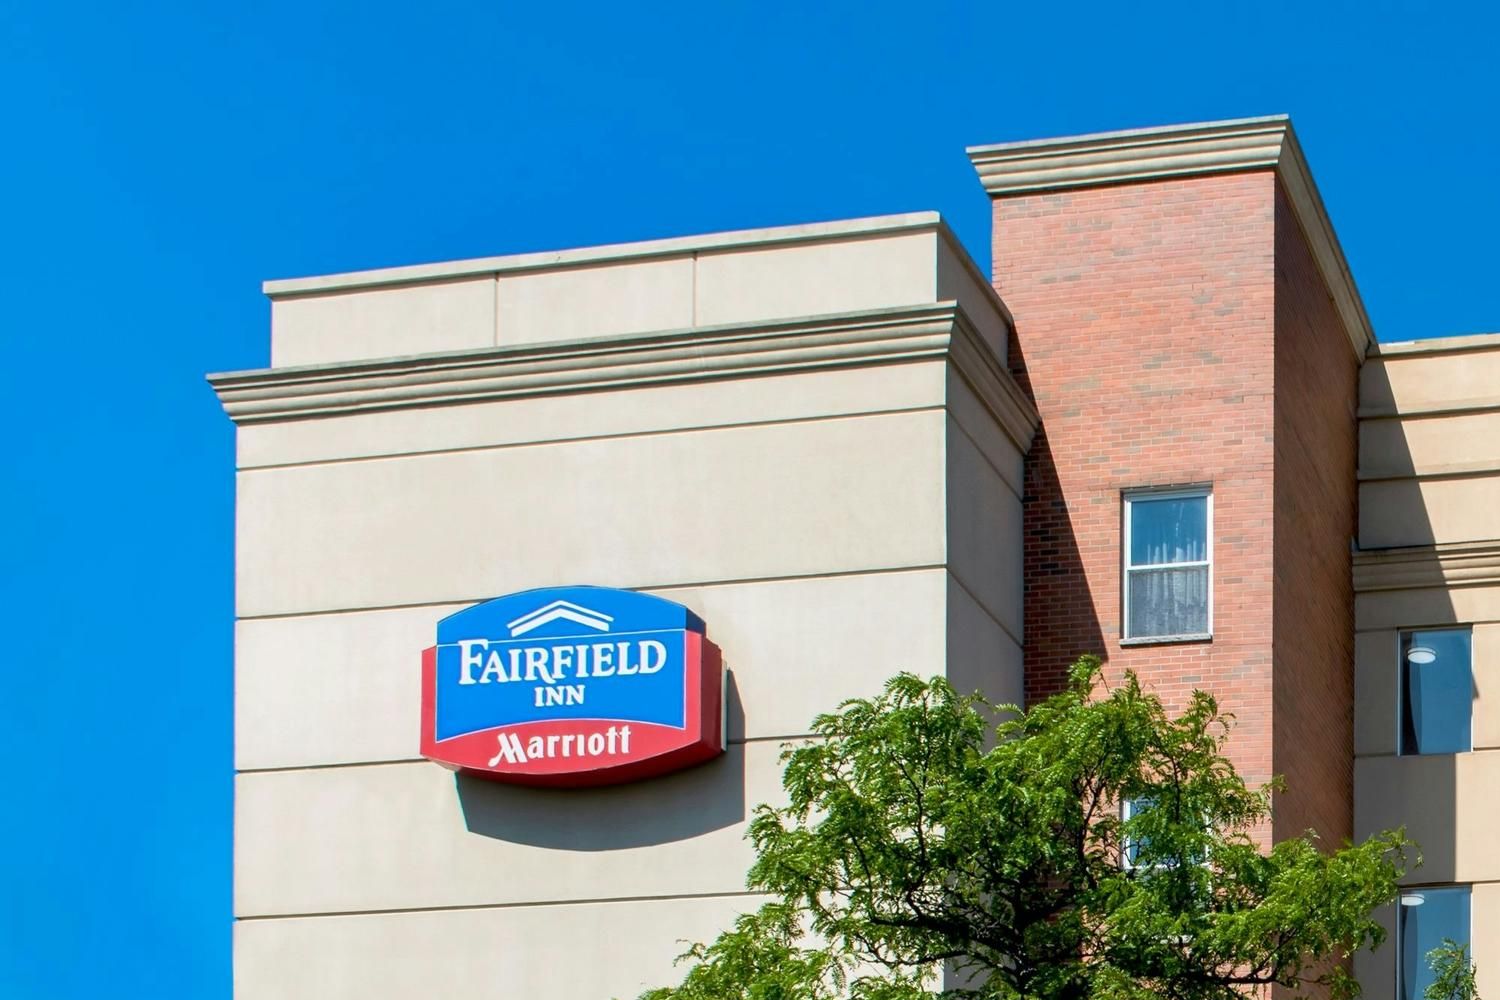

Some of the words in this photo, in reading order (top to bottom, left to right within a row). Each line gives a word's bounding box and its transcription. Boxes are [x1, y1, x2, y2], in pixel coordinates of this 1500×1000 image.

[458, 639, 667, 684] FAIRFIELD
[534, 685, 585, 707] INN
[488, 725, 631, 767] Marriott
